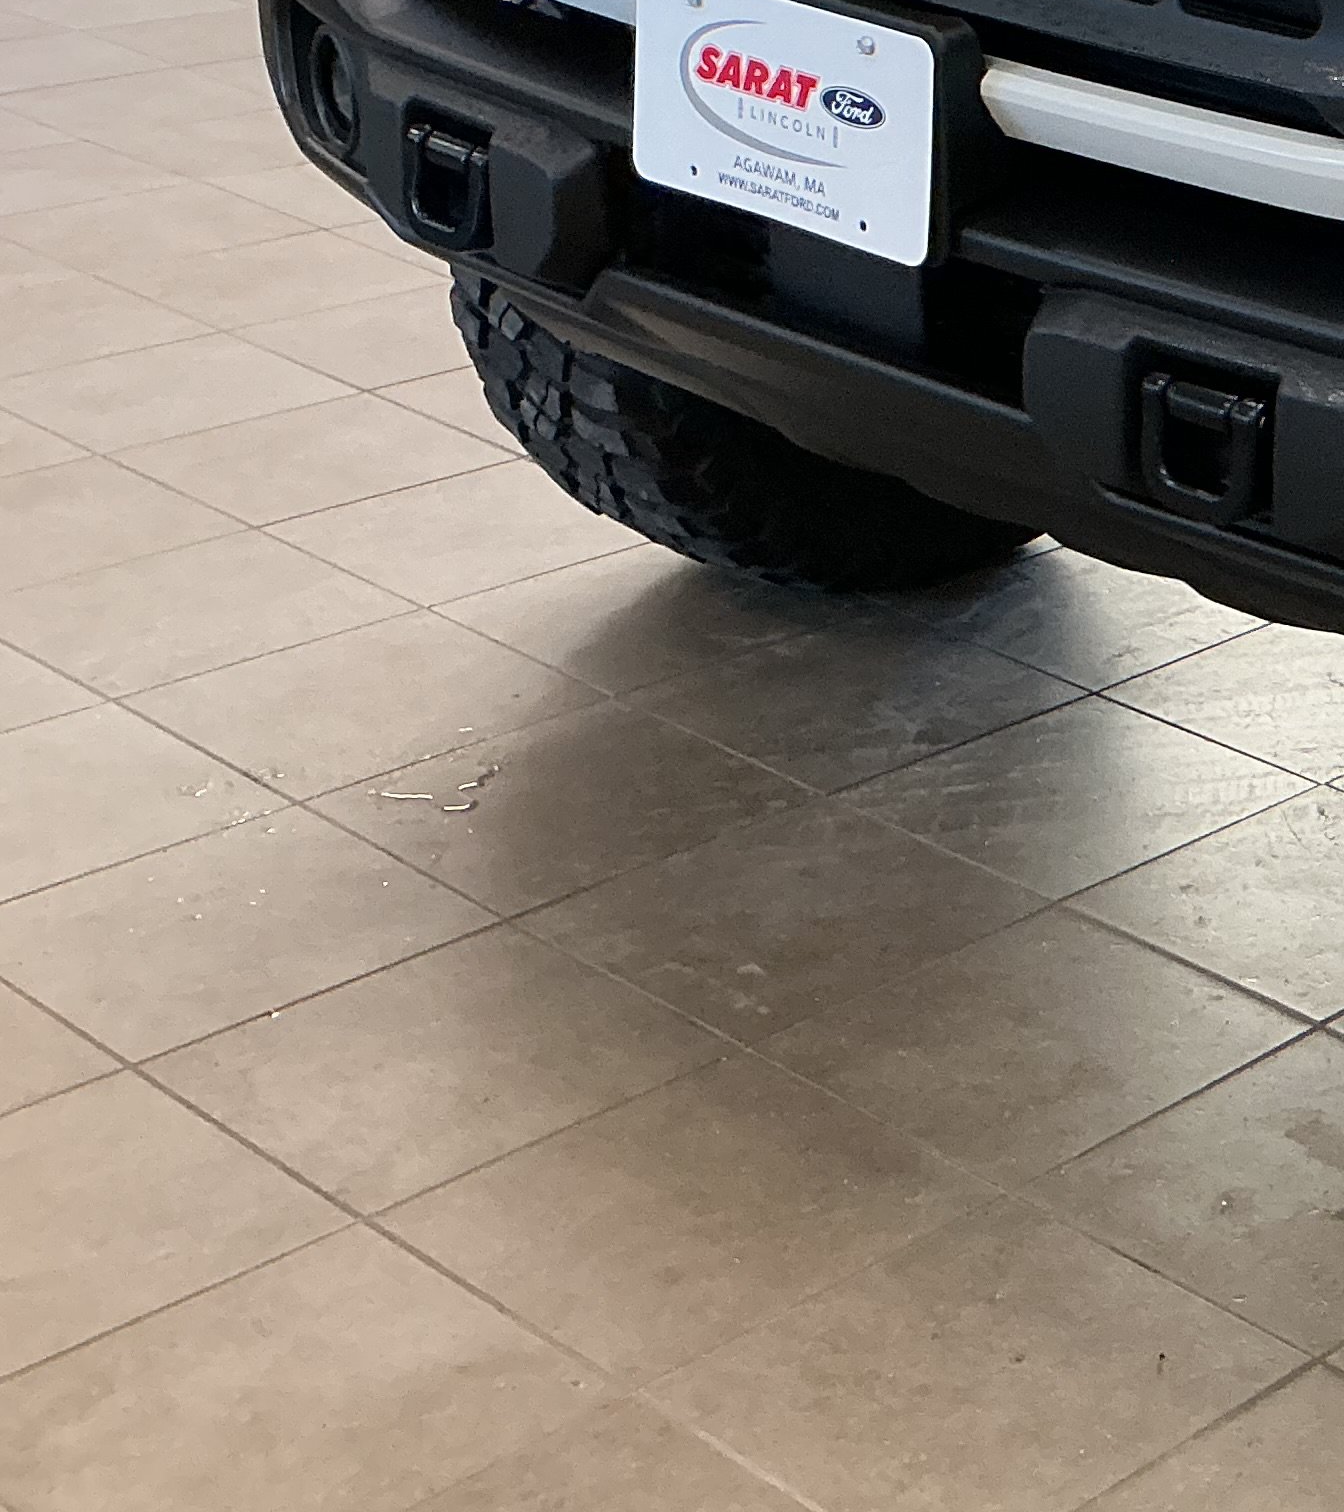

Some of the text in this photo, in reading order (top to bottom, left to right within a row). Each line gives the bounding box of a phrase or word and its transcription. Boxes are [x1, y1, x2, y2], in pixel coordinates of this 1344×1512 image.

[696, 43, 875, 125] SARAT Ford
[750, 104, 826, 140] LINCOLN
[718, 172, 840, 222] WWW.SARATFORD.COM
[733, 155, 826, 197] AGAWAM, MA
